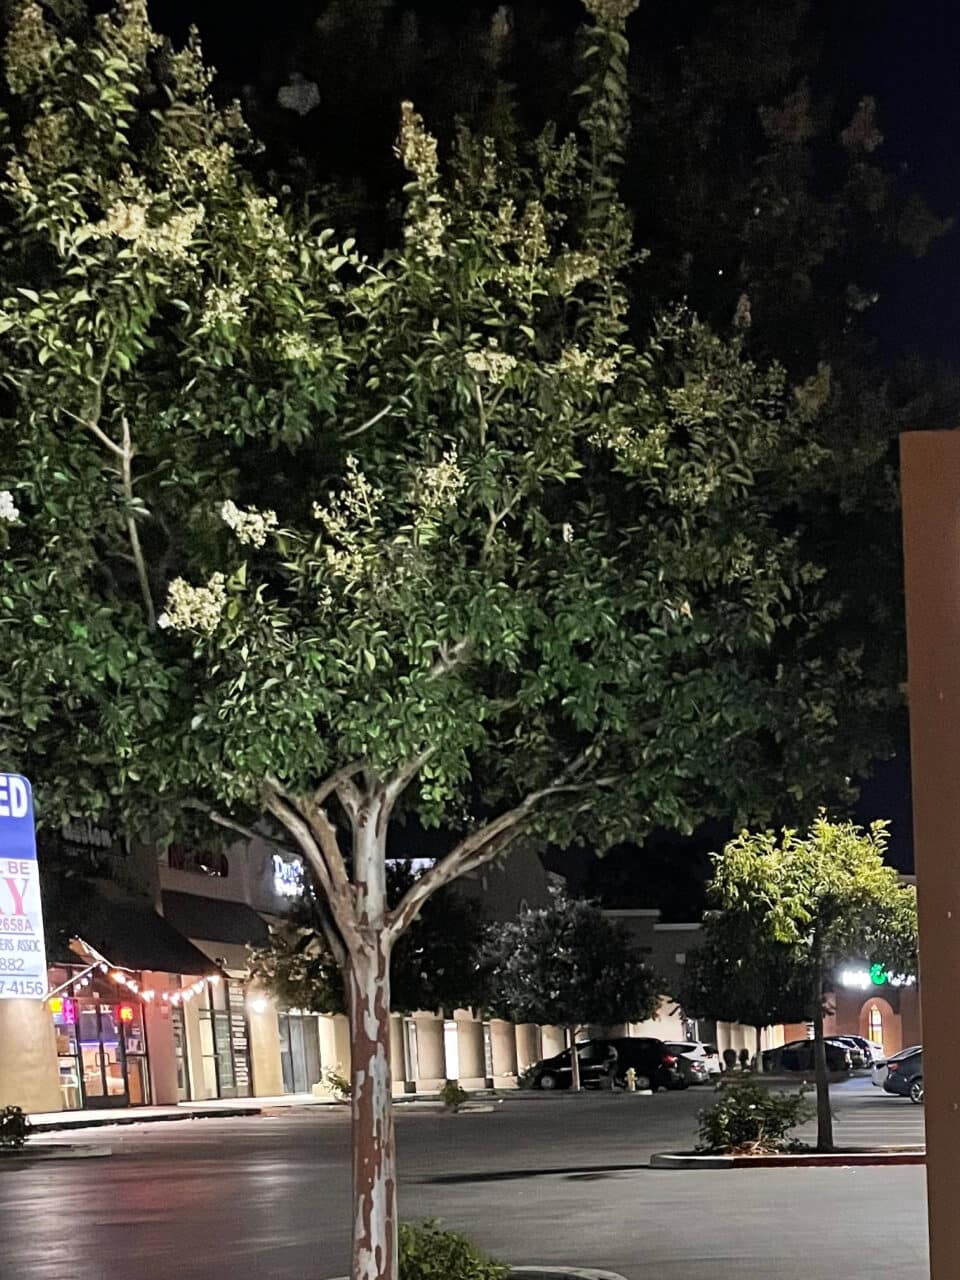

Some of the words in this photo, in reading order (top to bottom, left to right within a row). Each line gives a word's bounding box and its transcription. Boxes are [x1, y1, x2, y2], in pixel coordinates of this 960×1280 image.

[0, 775, 28, 818] ED
[8, 861, 30, 875] BE
[0, 877, 29, 916] Y
